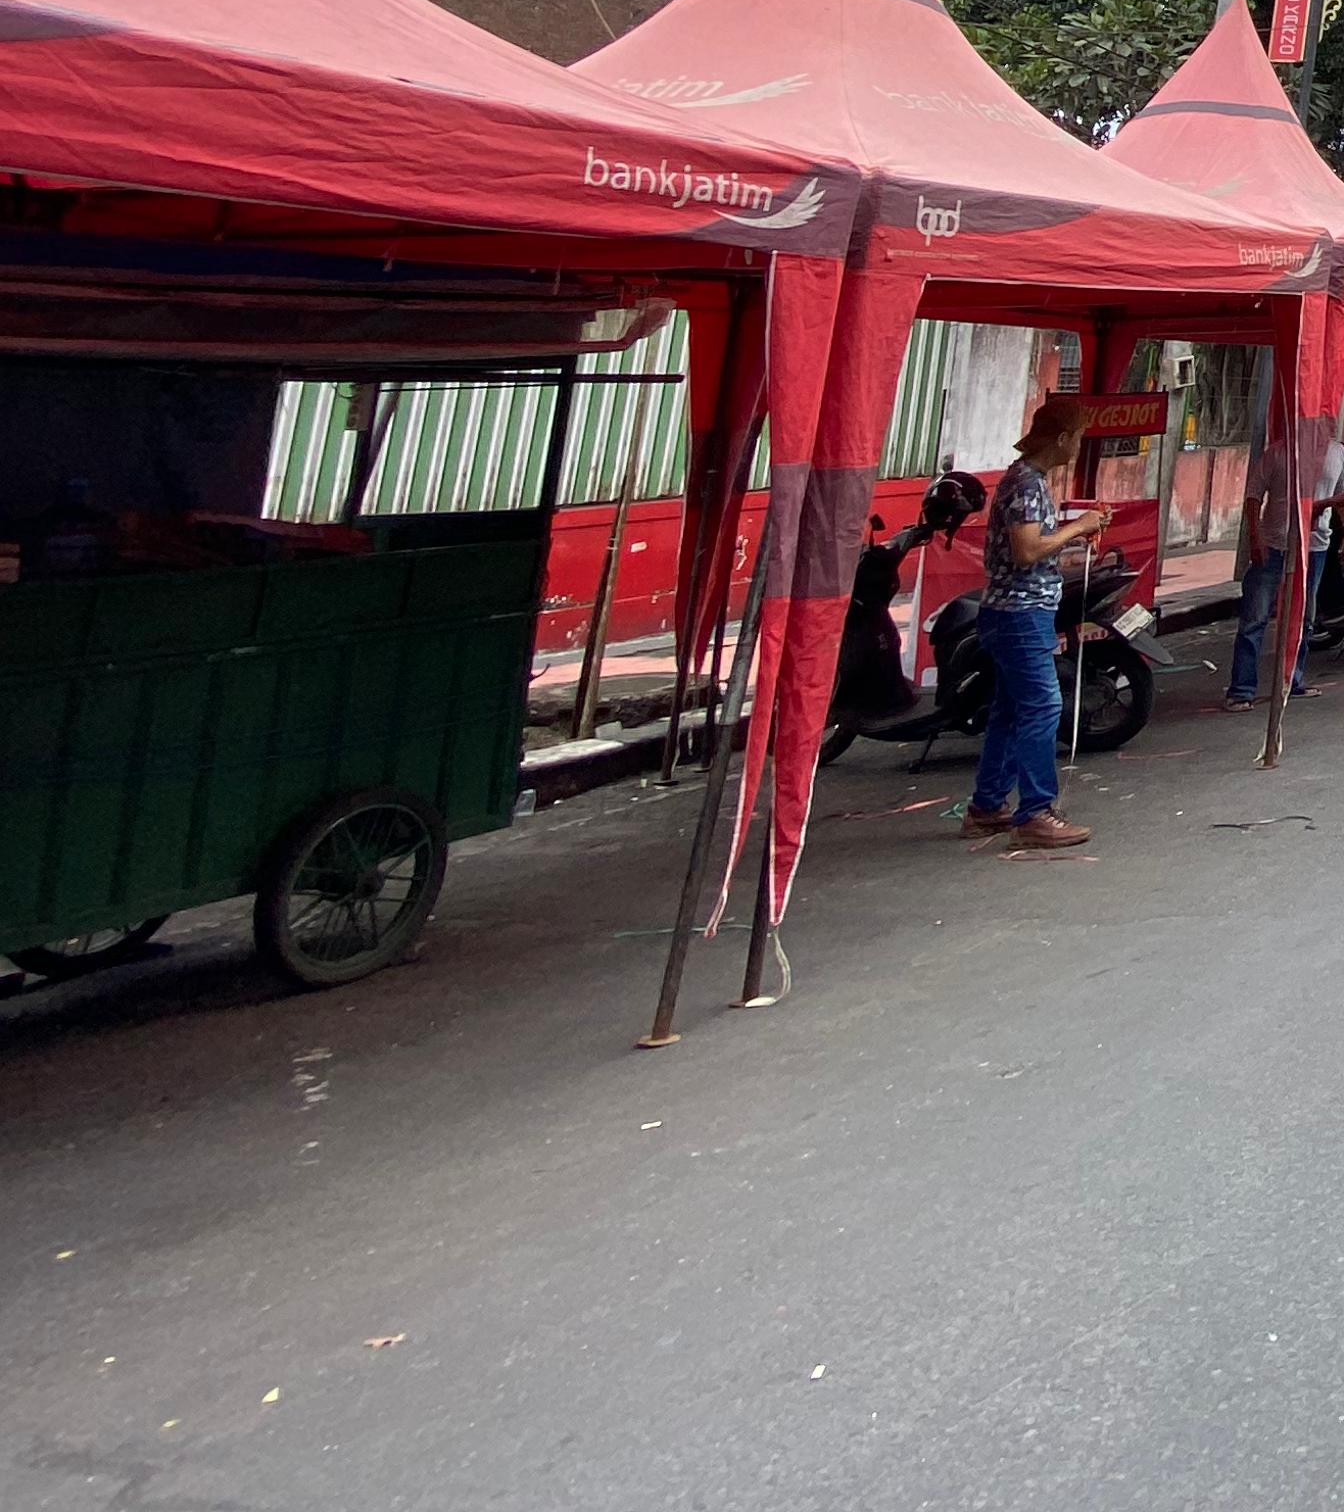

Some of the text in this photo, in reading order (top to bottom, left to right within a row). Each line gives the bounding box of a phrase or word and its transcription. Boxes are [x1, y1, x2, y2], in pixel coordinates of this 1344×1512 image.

[1279, 5, 1300, 55] KARNO
[584, 146, 773, 212] bankjatim
[1238, 243, 1305, 271] bankjatim
